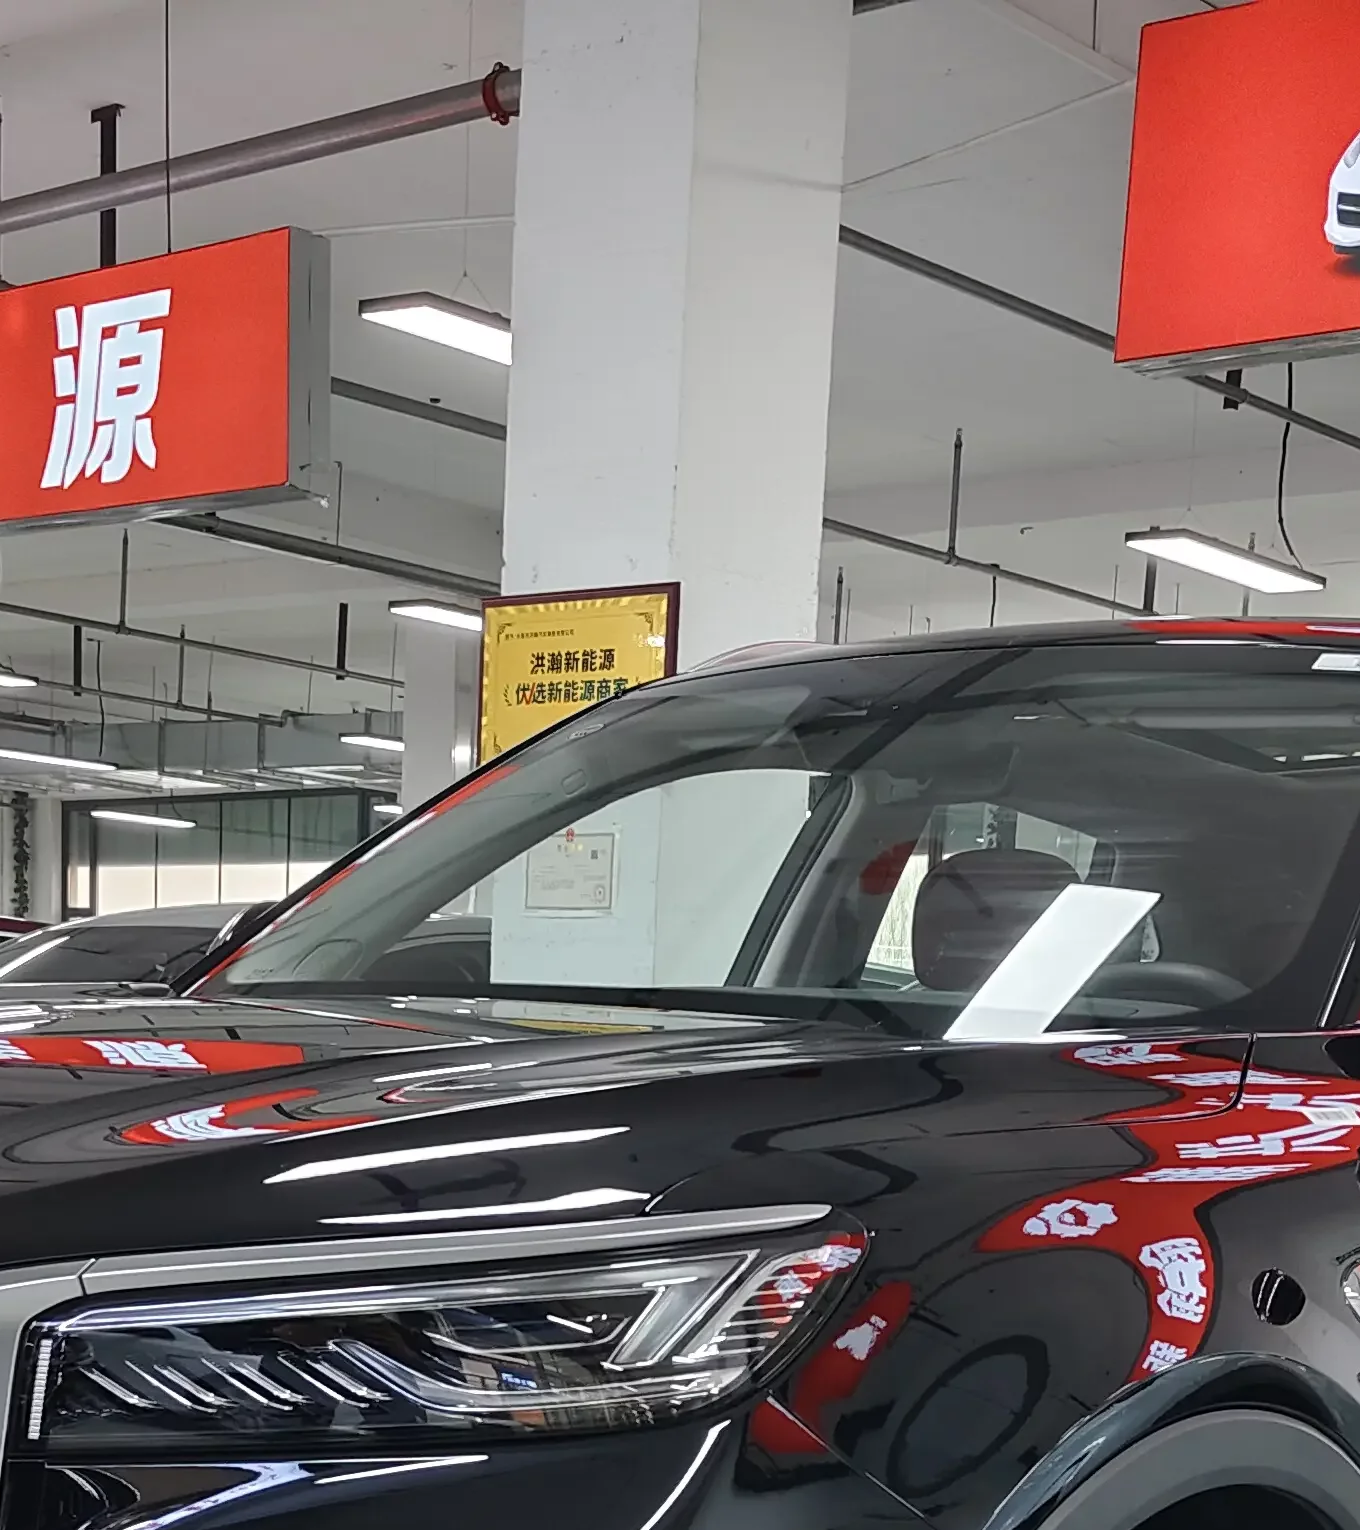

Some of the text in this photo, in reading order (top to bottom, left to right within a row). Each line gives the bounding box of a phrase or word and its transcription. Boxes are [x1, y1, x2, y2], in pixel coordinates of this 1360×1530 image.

[530, 649, 615, 674] 洪瀚新能源
